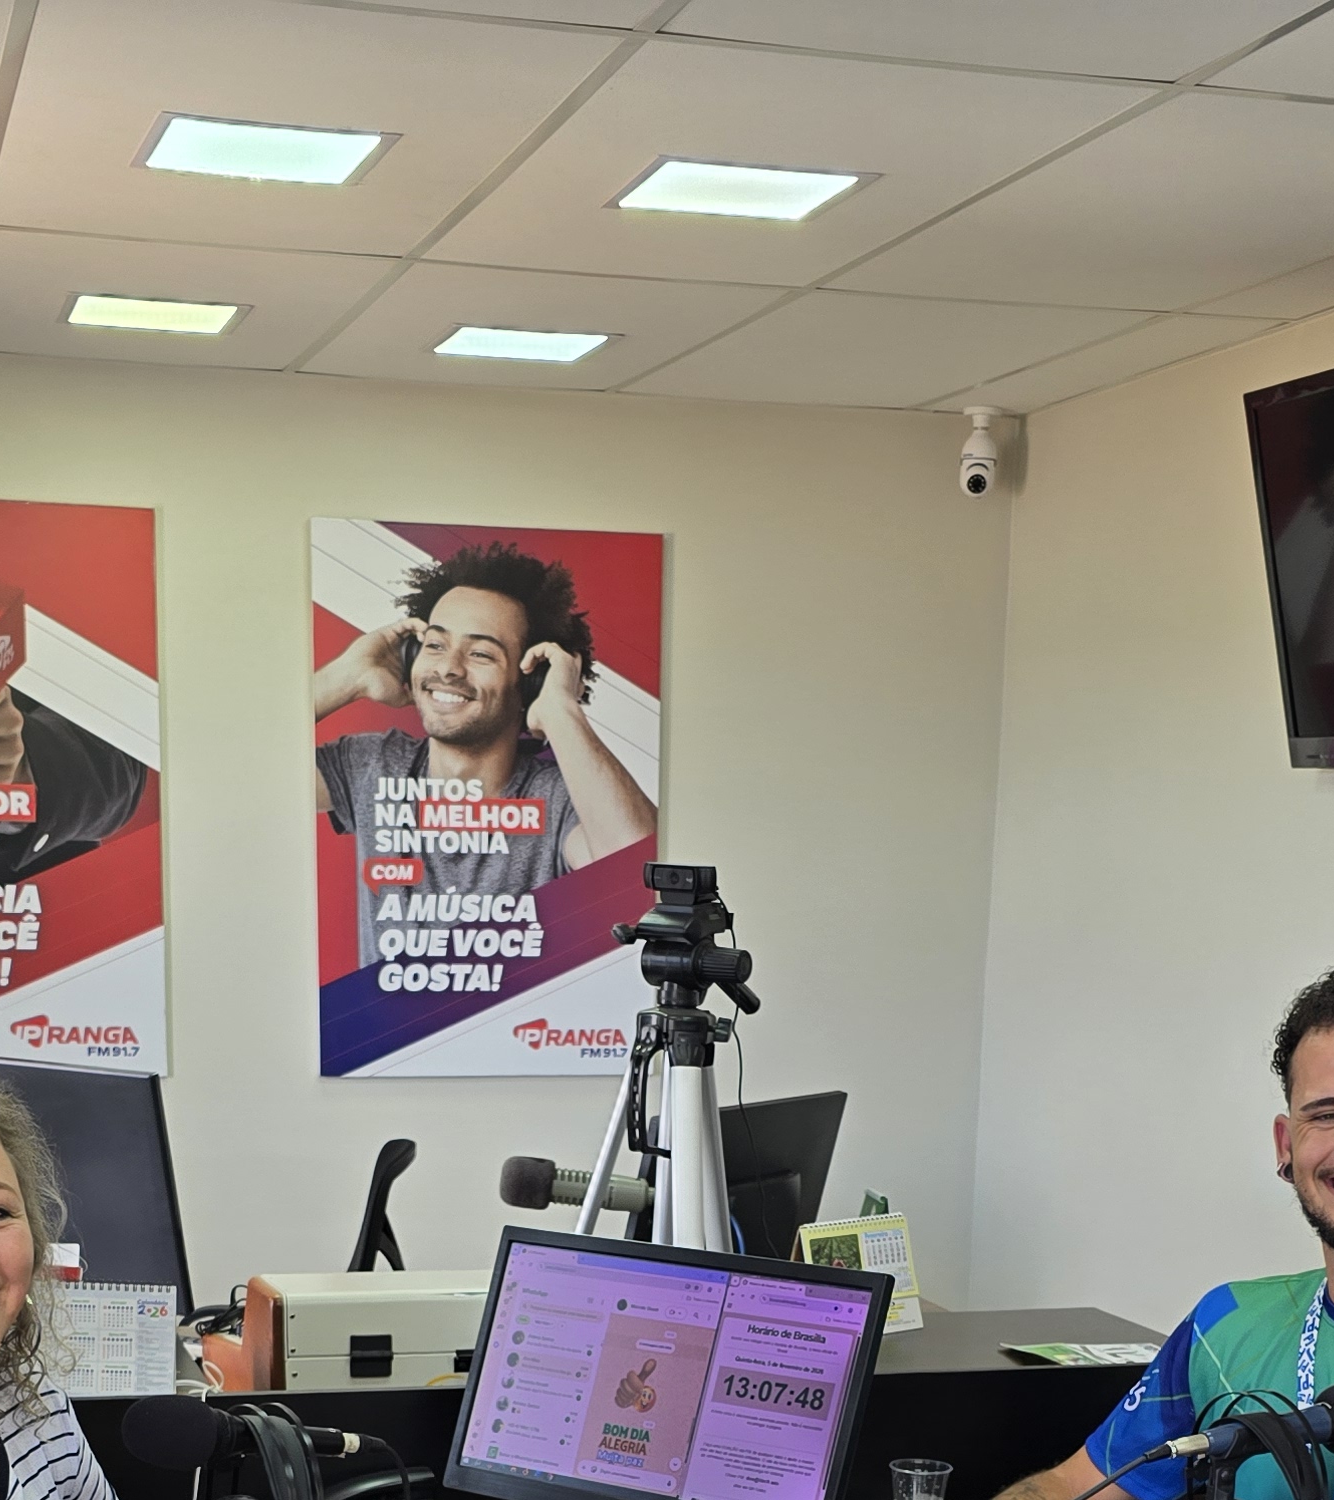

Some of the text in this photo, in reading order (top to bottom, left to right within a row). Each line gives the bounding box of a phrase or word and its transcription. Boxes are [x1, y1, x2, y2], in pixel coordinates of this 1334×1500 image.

[375, 777, 483, 802] JUNTOS
[376, 804, 540, 829] NA MELHOR
[375, 830, 509, 855] SINTONIA
[371, 863, 413, 881] COM
[377, 886, 537, 923] A MÚSICA
[379, 924, 544, 962] QUE VOCÊ
[378, 964, 503, 992] GOSTA!
[87, 1045, 140, 1057] FM 91.7
[581, 1047, 627, 1058] FM 91.7
[748, 1324, 826, 1343] Horário de Brasília
[723, 1375, 825, 1411] 13:07:48
[603, 1423, 650, 1442] BOM DIA
[599, 1437, 647, 1455] ALEGRIA
[596, 1450, 644, 1467] Muita paz
